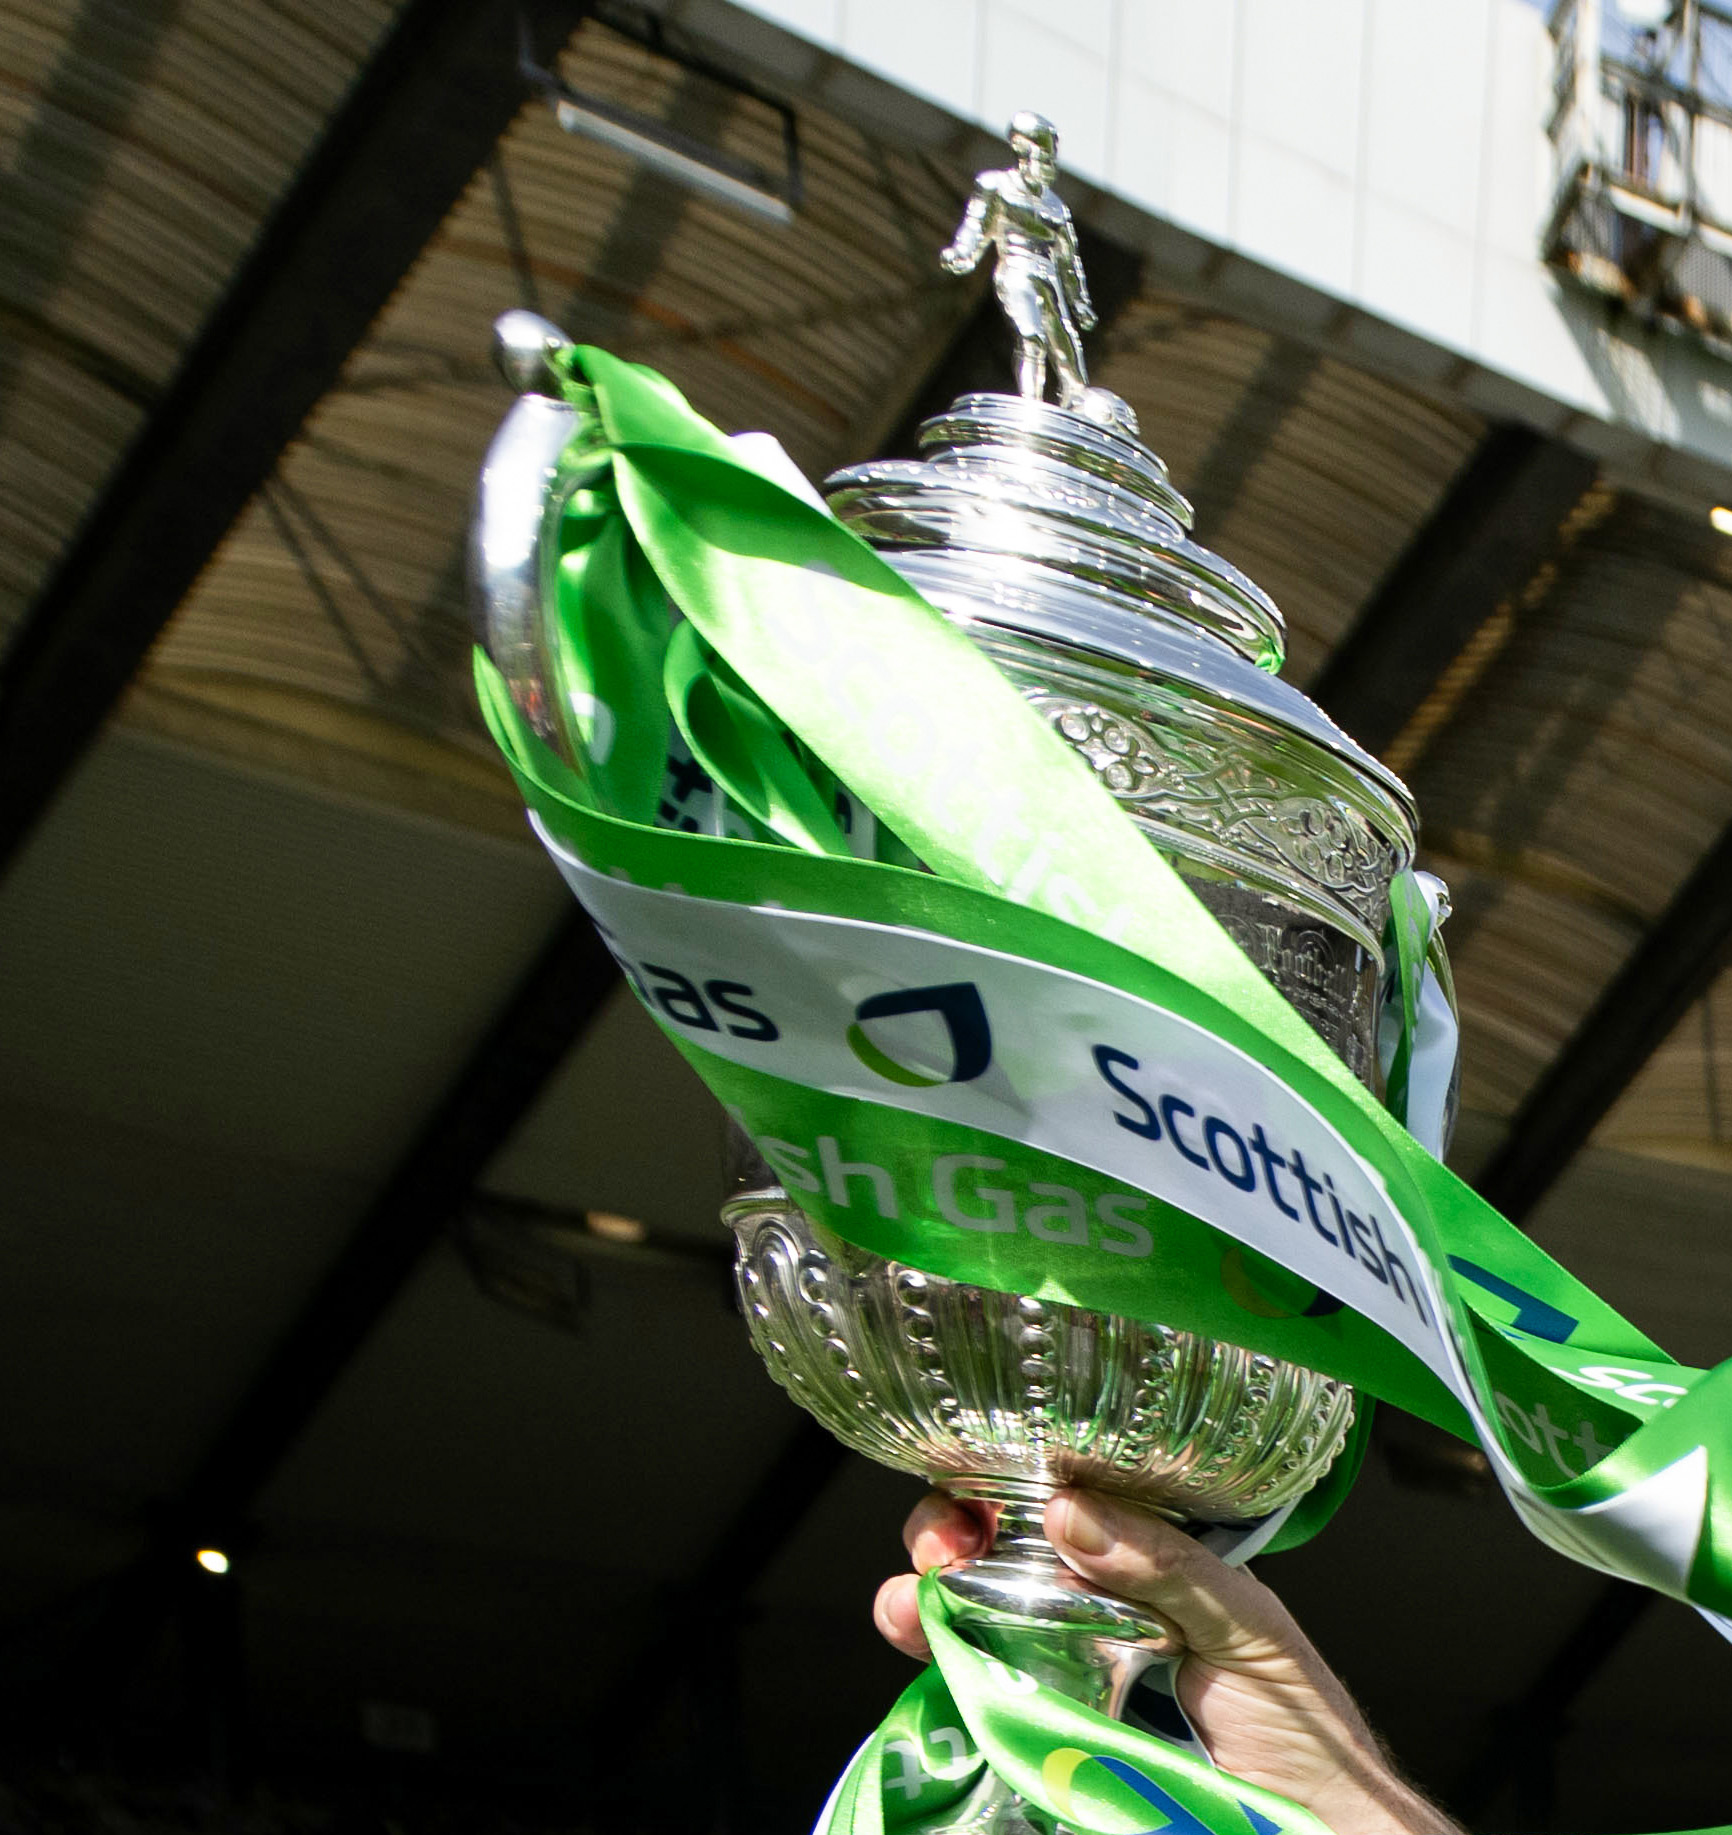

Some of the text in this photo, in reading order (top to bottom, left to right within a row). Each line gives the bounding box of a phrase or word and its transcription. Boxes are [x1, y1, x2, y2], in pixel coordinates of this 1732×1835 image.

[618, 950, 780, 1042] as
[930, 1152, 1155, 1259] Gas
[1092, 1044, 1429, 1326] Scottish
